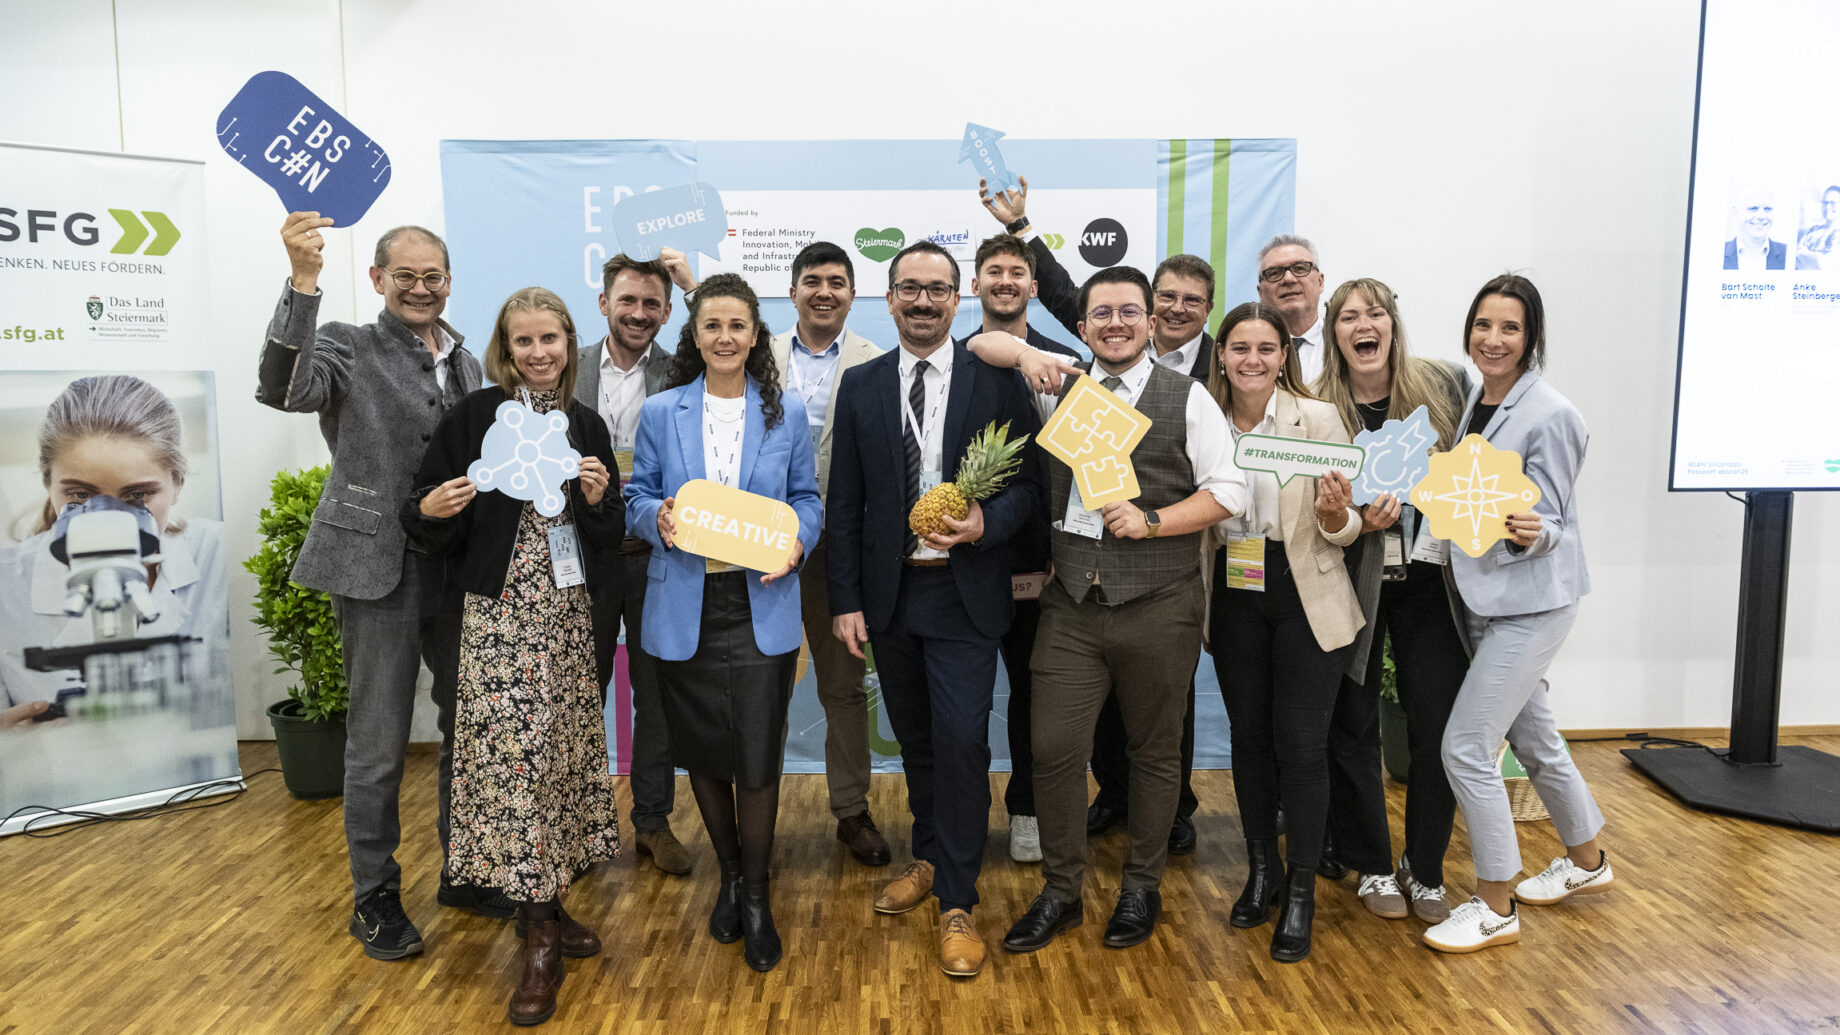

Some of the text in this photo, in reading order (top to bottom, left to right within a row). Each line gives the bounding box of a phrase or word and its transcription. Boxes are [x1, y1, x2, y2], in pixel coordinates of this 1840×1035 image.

[286, 105, 351, 164] EBS
[970, 130, 996, 174] BOOST
[264, 134, 331, 194] C#N
[750, 209, 759, 218] by
[0, 207, 100, 247] SFG
[636, 208, 706, 236] EXPLORE
[742, 228, 816, 239] Federal Ministry
[1078, 231, 1117, 247] KWF
[742, 240, 792, 250] Innovation,
[855, 237, 905, 251] Steiermark
[742, 251, 759, 261] and
[52, 259, 96, 272] NEUES
[100, 259, 167, 275] FÖRDERN.
[742, 263, 781, 274] Republic
[1721, 282, 1776, 291] Bart Scholte
[1792, 282, 1817, 292] Anke
[109, 296, 164, 310] Das Land
[1721, 292, 1763, 300] van Mast
[107, 312, 166, 324] Steiermark
[1469, 442, 1482, 456] N
[1243, 447, 1358, 469] #TRANSFORMATION
[1418, 489, 1534, 503] W O
[679, 505, 791, 551] CREATIVE
[1471, 538, 1481, 551] S
